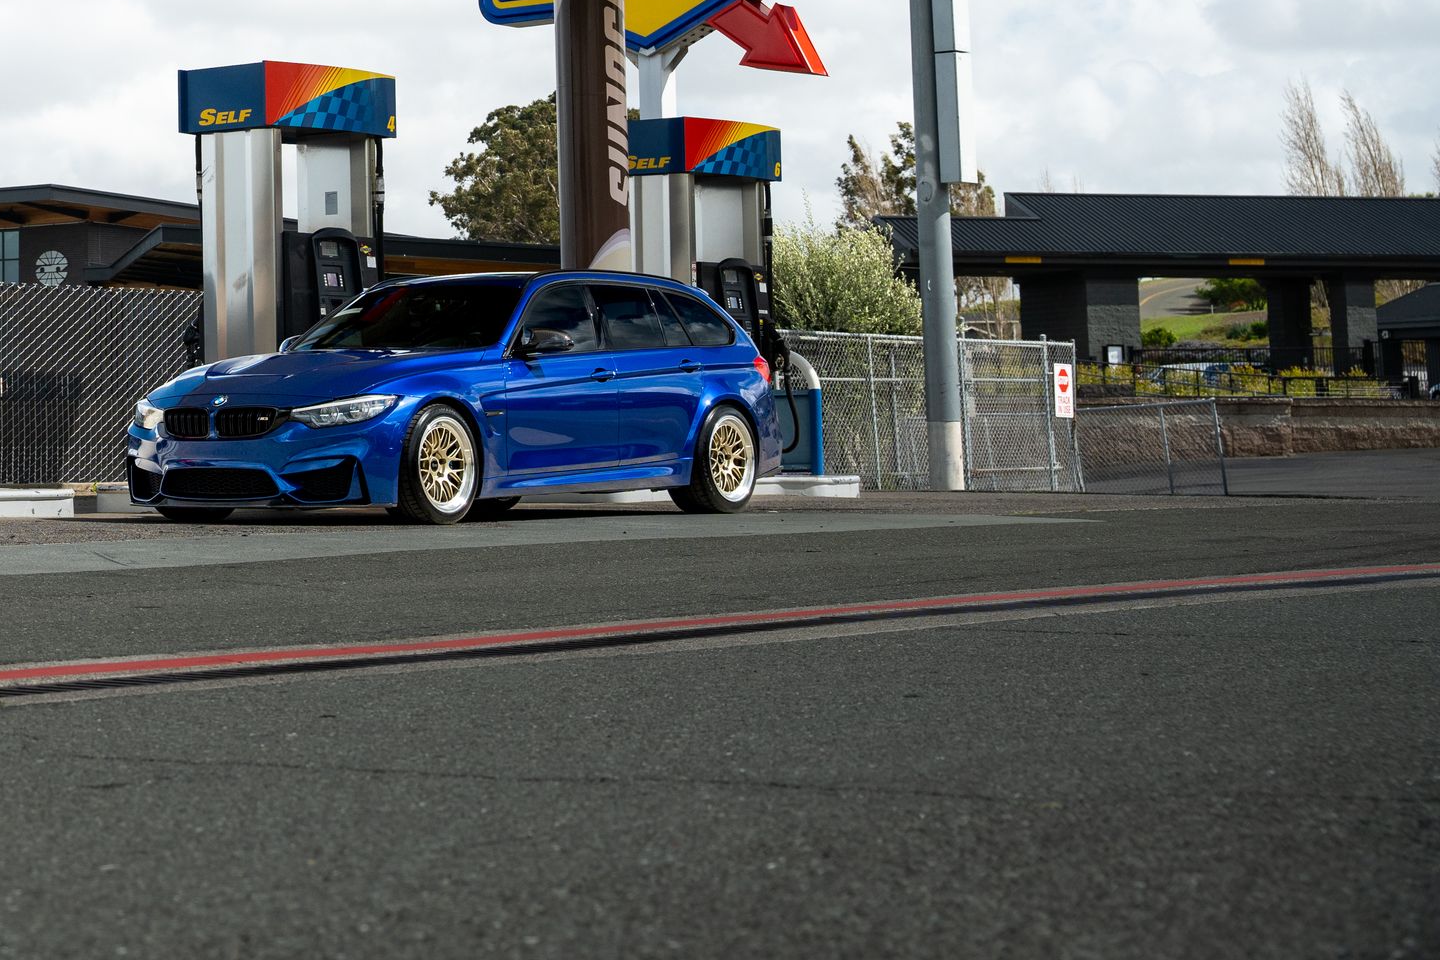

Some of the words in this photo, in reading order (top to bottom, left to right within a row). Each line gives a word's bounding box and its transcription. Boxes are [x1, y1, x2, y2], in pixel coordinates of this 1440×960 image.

[386, 115, 396, 133] 4
[774, 162, 781, 177] 6
[1057, 396, 1071, 404] TRACK
[1063, 405, 1071, 414] USE
